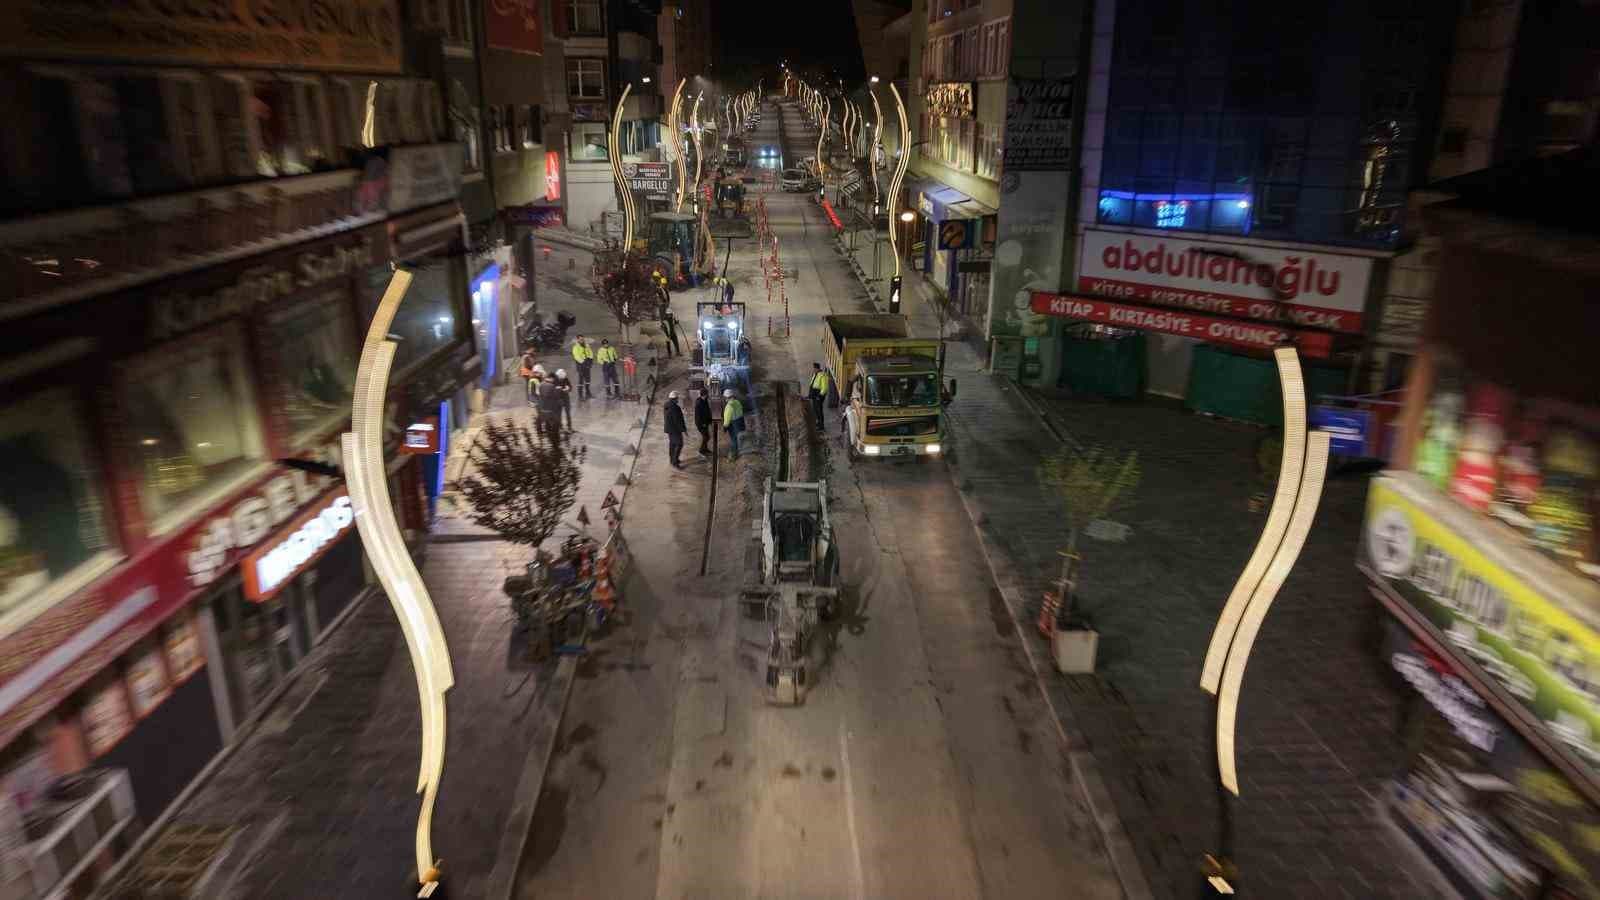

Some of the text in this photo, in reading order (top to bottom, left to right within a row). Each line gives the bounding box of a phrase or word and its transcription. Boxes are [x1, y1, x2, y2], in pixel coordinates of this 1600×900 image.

[632, 179, 667, 190] BARGELLO
[1103, 240, 1340, 300] abdullahoğlu
[1092, 280, 1135, 297] KİTAP
[1151, 289, 1233, 313] KIRTASİYE
[1050, 297, 1093, 316] KİTAP
[1109, 307, 1191, 332] KIRTASİYE
